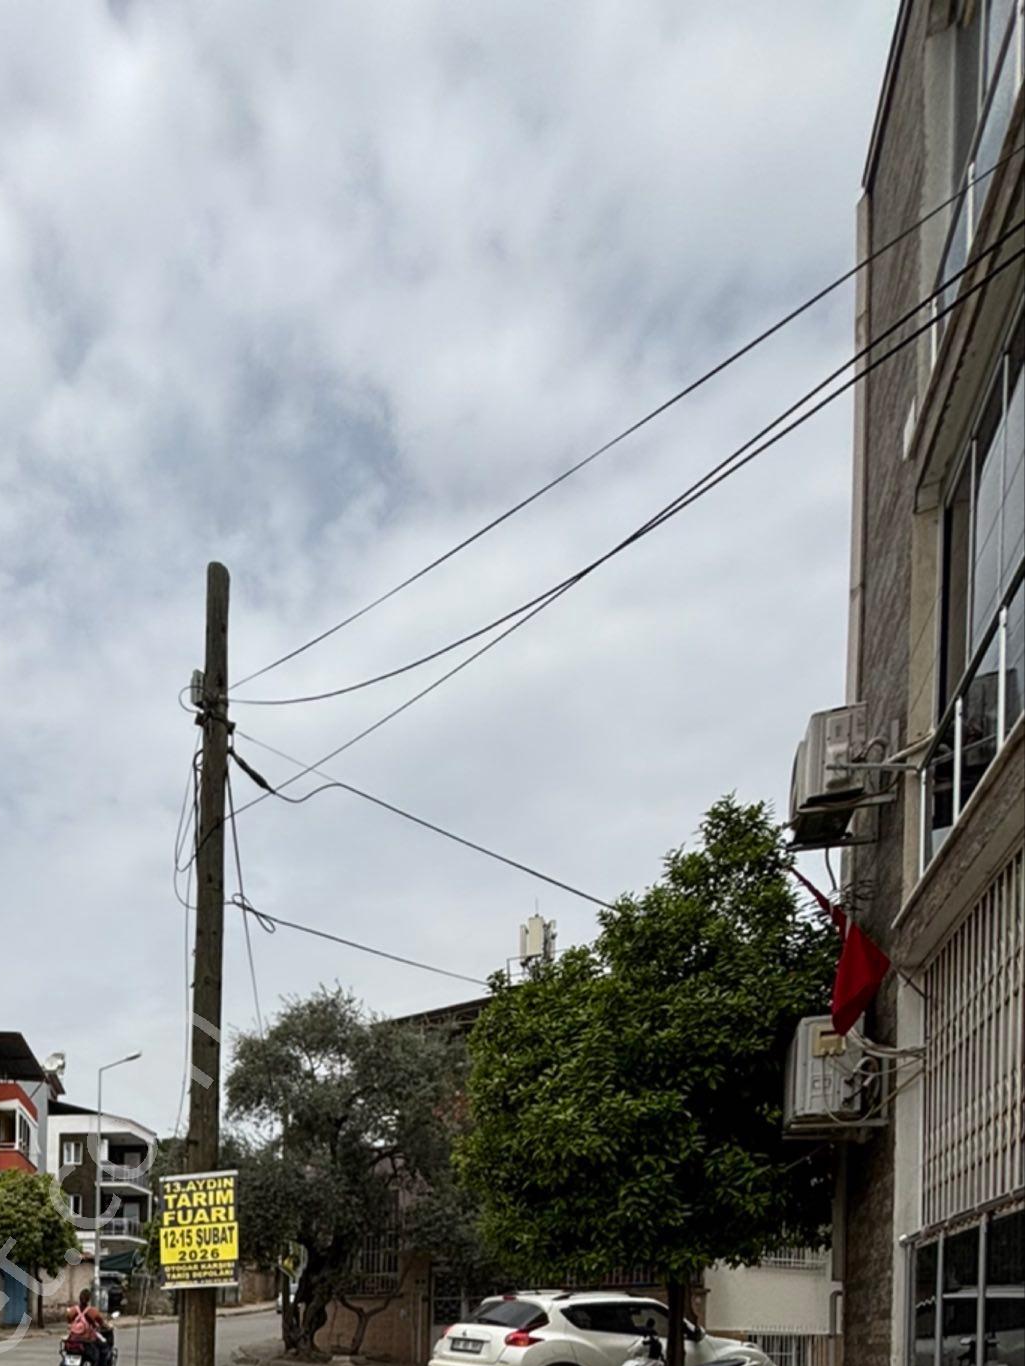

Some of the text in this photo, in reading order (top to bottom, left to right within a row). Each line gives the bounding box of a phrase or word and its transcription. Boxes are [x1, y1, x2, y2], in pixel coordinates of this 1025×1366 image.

[164, 1177, 234, 1193] 13.AYDIN
[163, 1189, 234, 1209] TARIM
[163, 1206, 234, 1226] FUARI
[196, 1226, 235, 1248] ŞUBAT
[178, 1248, 220, 1261] 2026
